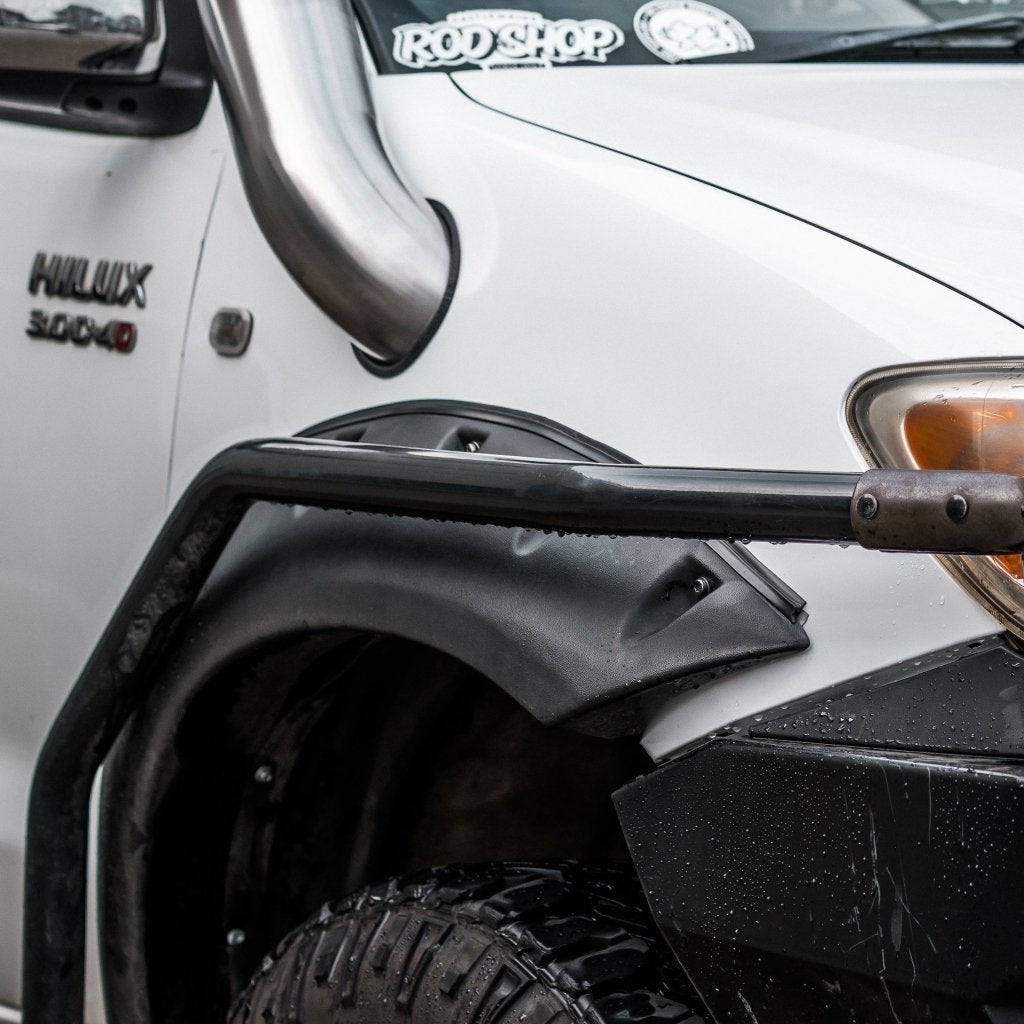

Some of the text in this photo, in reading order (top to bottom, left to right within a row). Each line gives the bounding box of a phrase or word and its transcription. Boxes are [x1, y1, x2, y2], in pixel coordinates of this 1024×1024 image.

[399, 25, 495, 63] ROD
[497, 21, 617, 61] SHOP
[28, 251, 153, 309] HILUX
